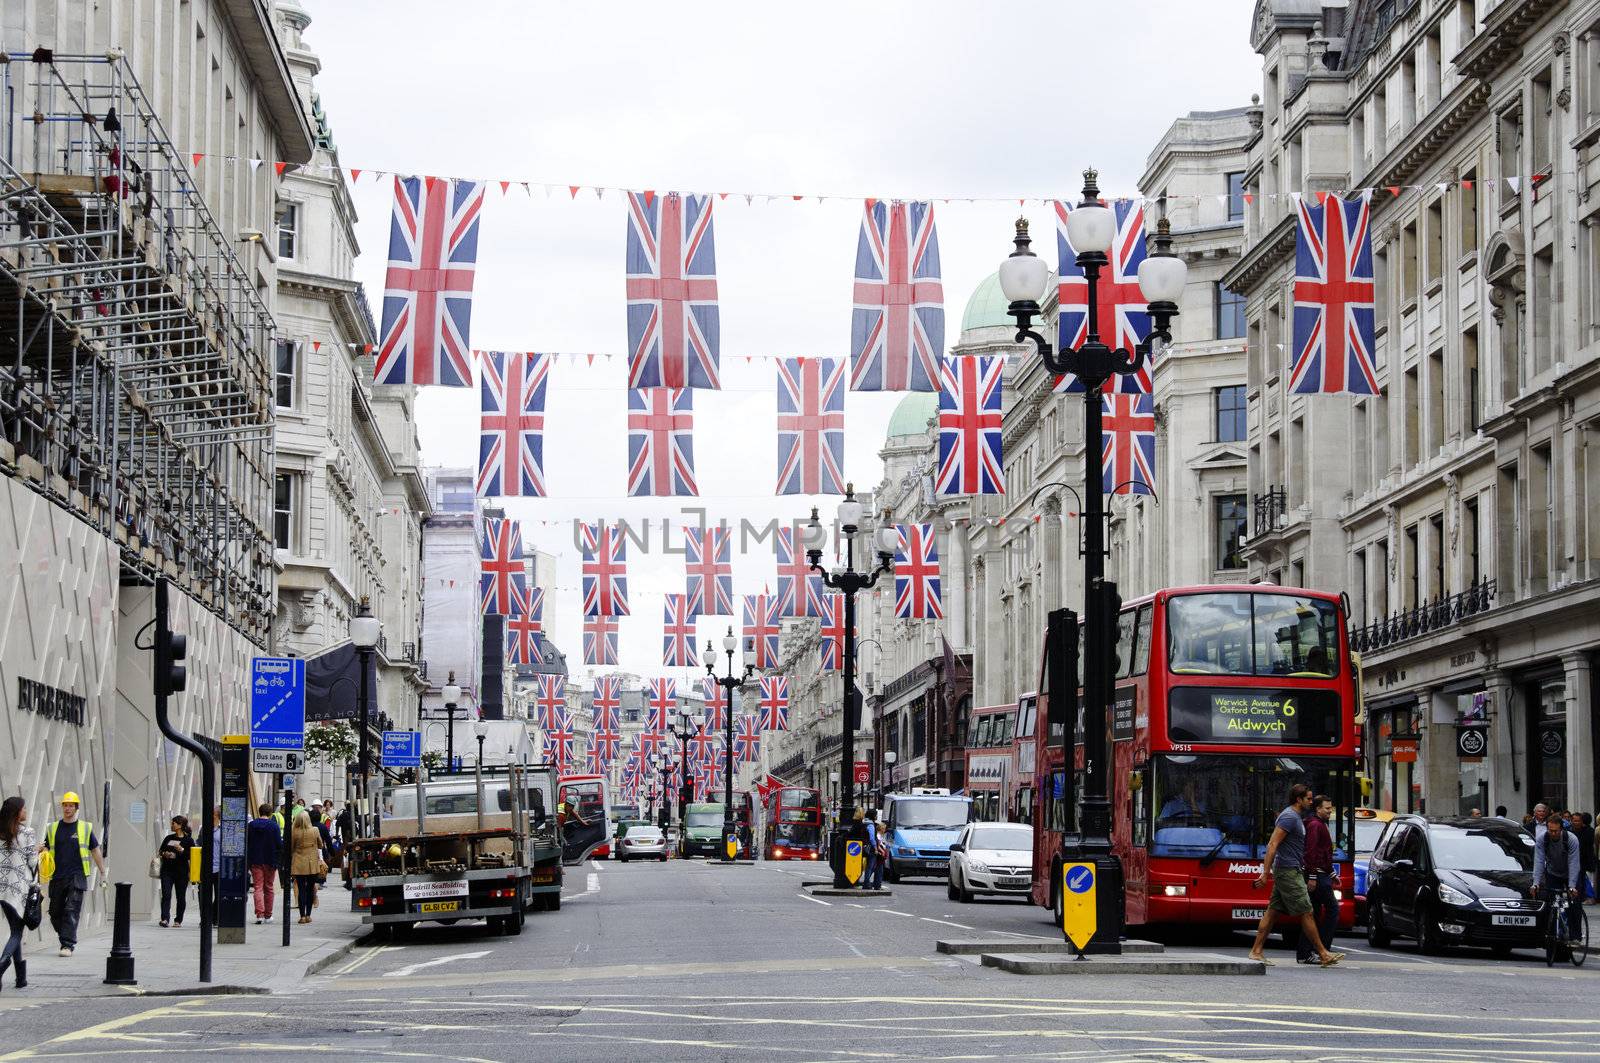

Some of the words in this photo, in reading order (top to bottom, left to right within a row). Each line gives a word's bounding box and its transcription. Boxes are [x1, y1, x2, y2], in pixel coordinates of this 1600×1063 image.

[1215, 698, 1248, 706] Warwick
[1251, 699, 1280, 707] Avenue
[1219, 706, 1248, 714] Oxford
[1250, 707, 1275, 715] Circus
[1282, 698, 1296, 717] 6
[1227, 718, 1286, 734] Aldwych
[252, 736, 269, 744] 11am
[273, 737, 302, 746] Midnight
[270, 753, 283, 761] lane
[431, 882, 467, 890] Scaffolding
[440, 902, 455, 910] CVZ
[1234, 910, 1256, 918] LK04
[1498, 916, 1513, 924] LR11
[1514, 917, 1530, 925] KWP
